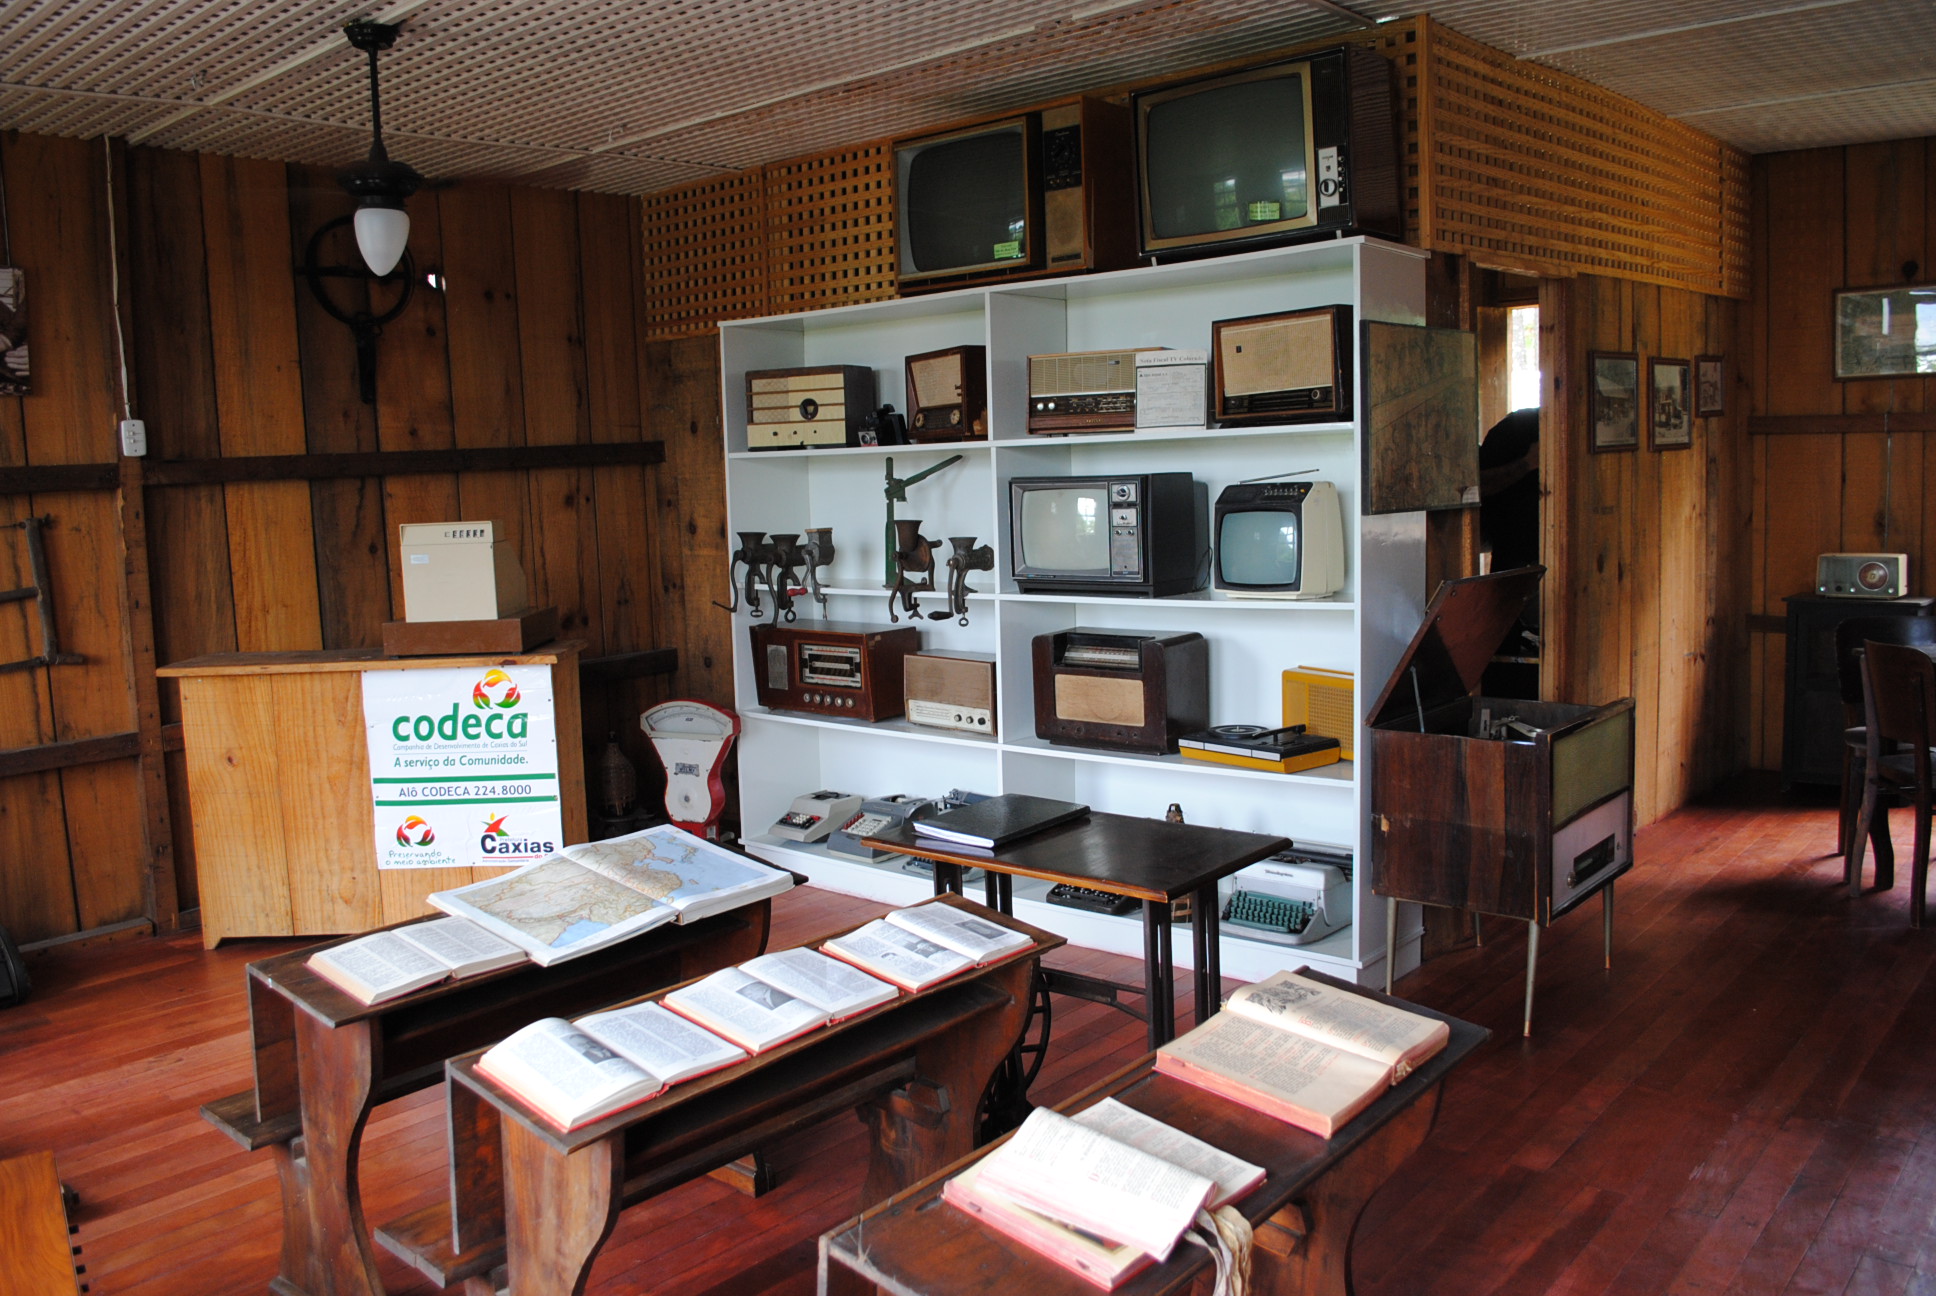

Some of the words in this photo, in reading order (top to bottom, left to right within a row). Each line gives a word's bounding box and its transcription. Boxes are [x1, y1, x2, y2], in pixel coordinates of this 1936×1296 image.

[392, 702, 528, 741] codeca
[394, 757, 401, 767] A
[404, 756, 440, 770] serviço
[442, 755, 456, 767] da
[459, 753, 529, 766] Comunidade.
[398, 786, 418, 798] Alô
[421, 786, 471, 797] CODECA
[474, 784, 532, 796] 224.8000
[480, 833, 555, 854] Caxias
[388, 849, 442, 858] Preservando
